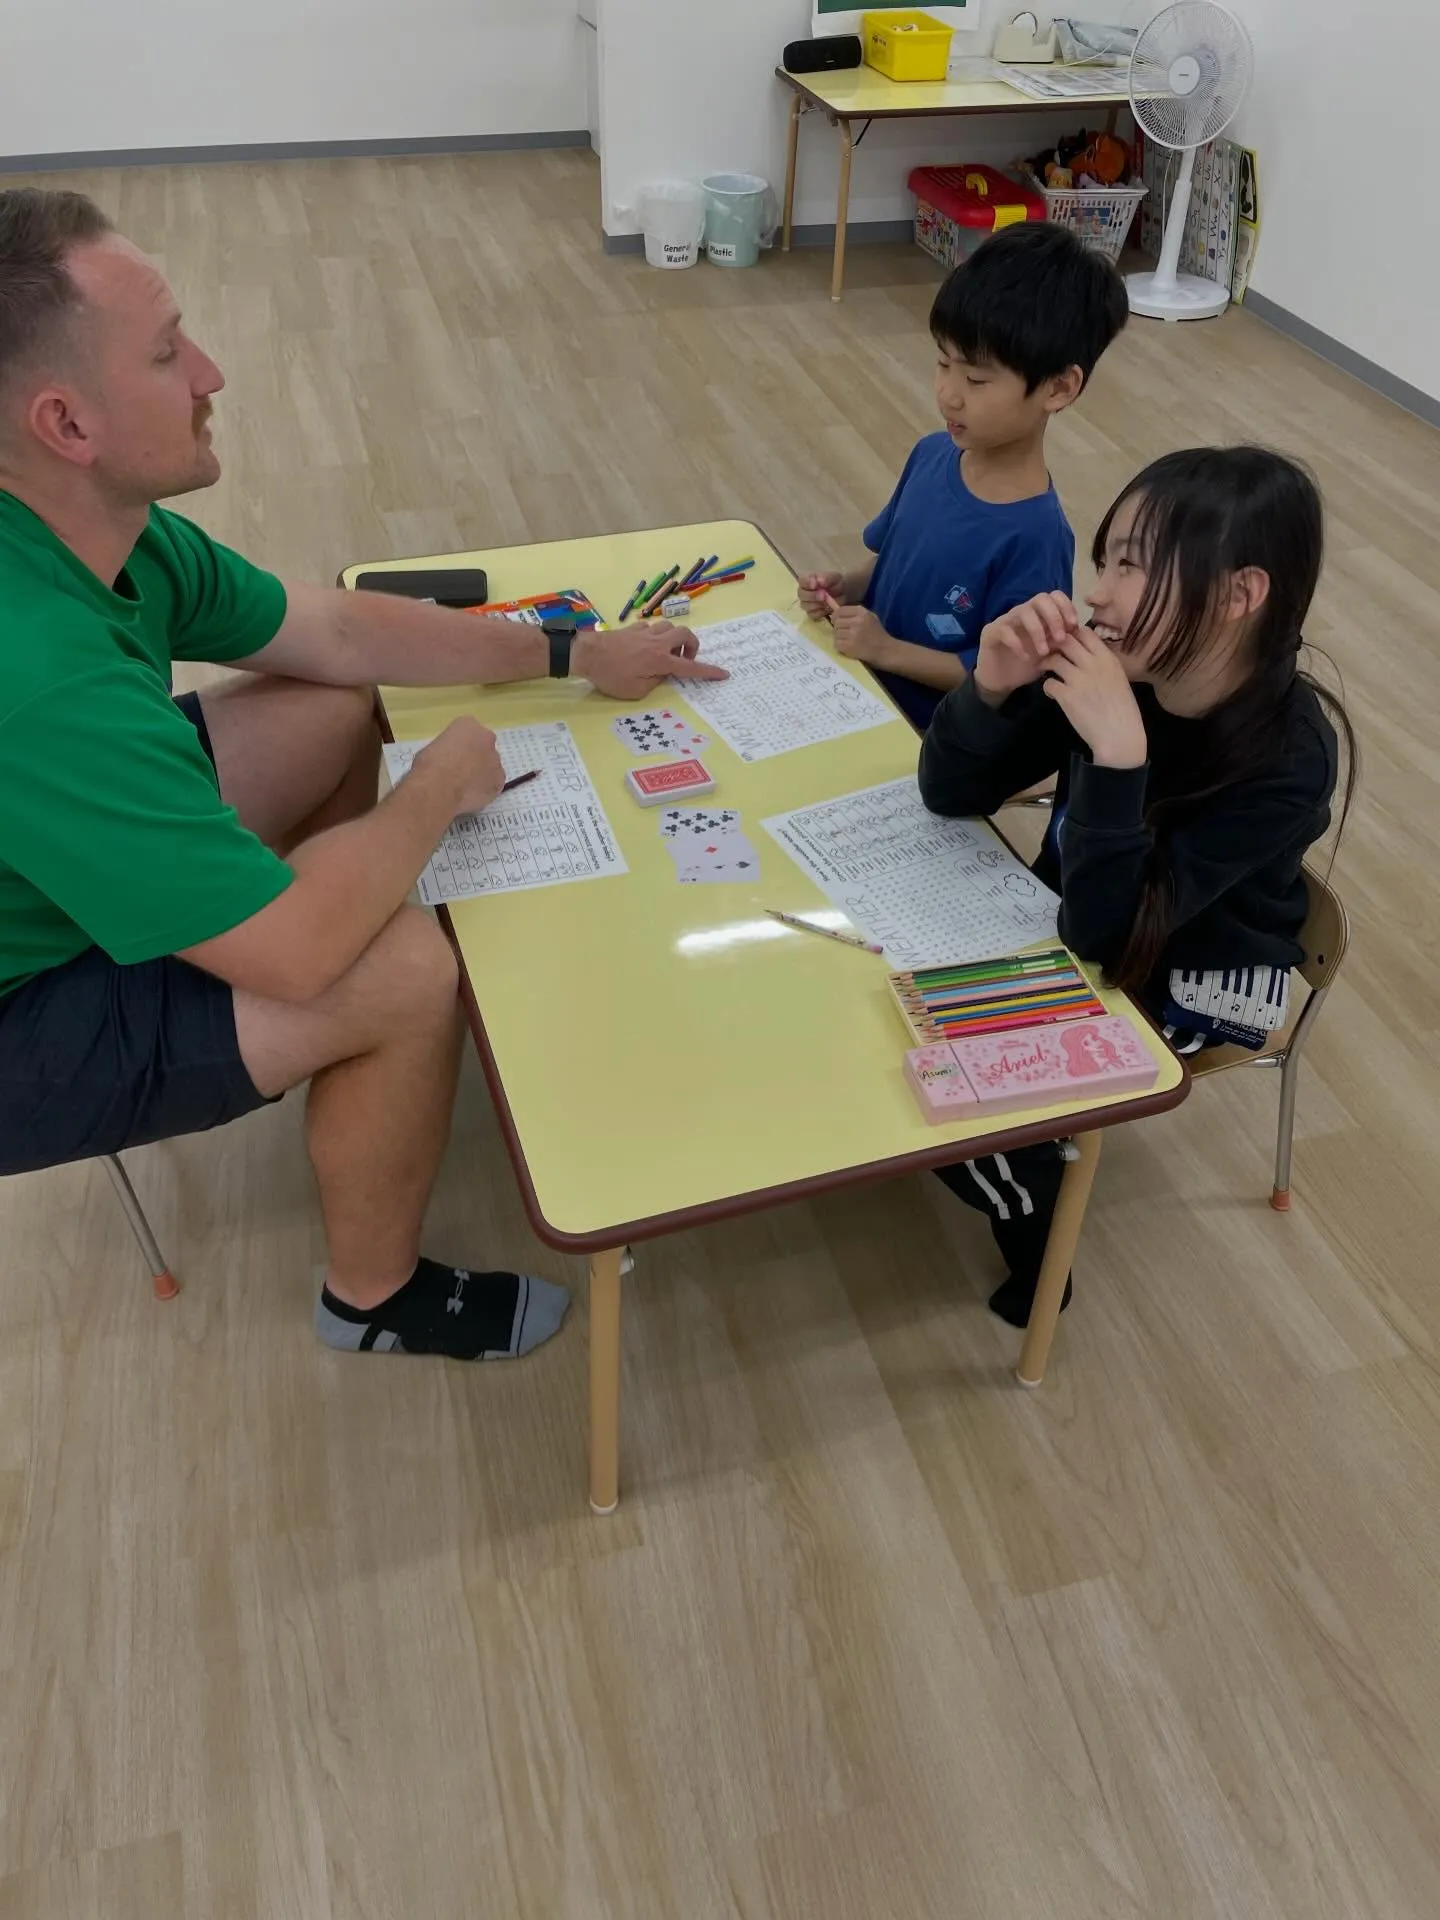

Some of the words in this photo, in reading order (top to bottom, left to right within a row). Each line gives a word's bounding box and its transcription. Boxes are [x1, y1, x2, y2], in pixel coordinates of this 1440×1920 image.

[666, 254, 689, 263] Waste
[710, 246, 732, 257] Plastic
[845, 894, 928, 968] WEATHER
[988, 1043, 1048, 1080] Ariel
